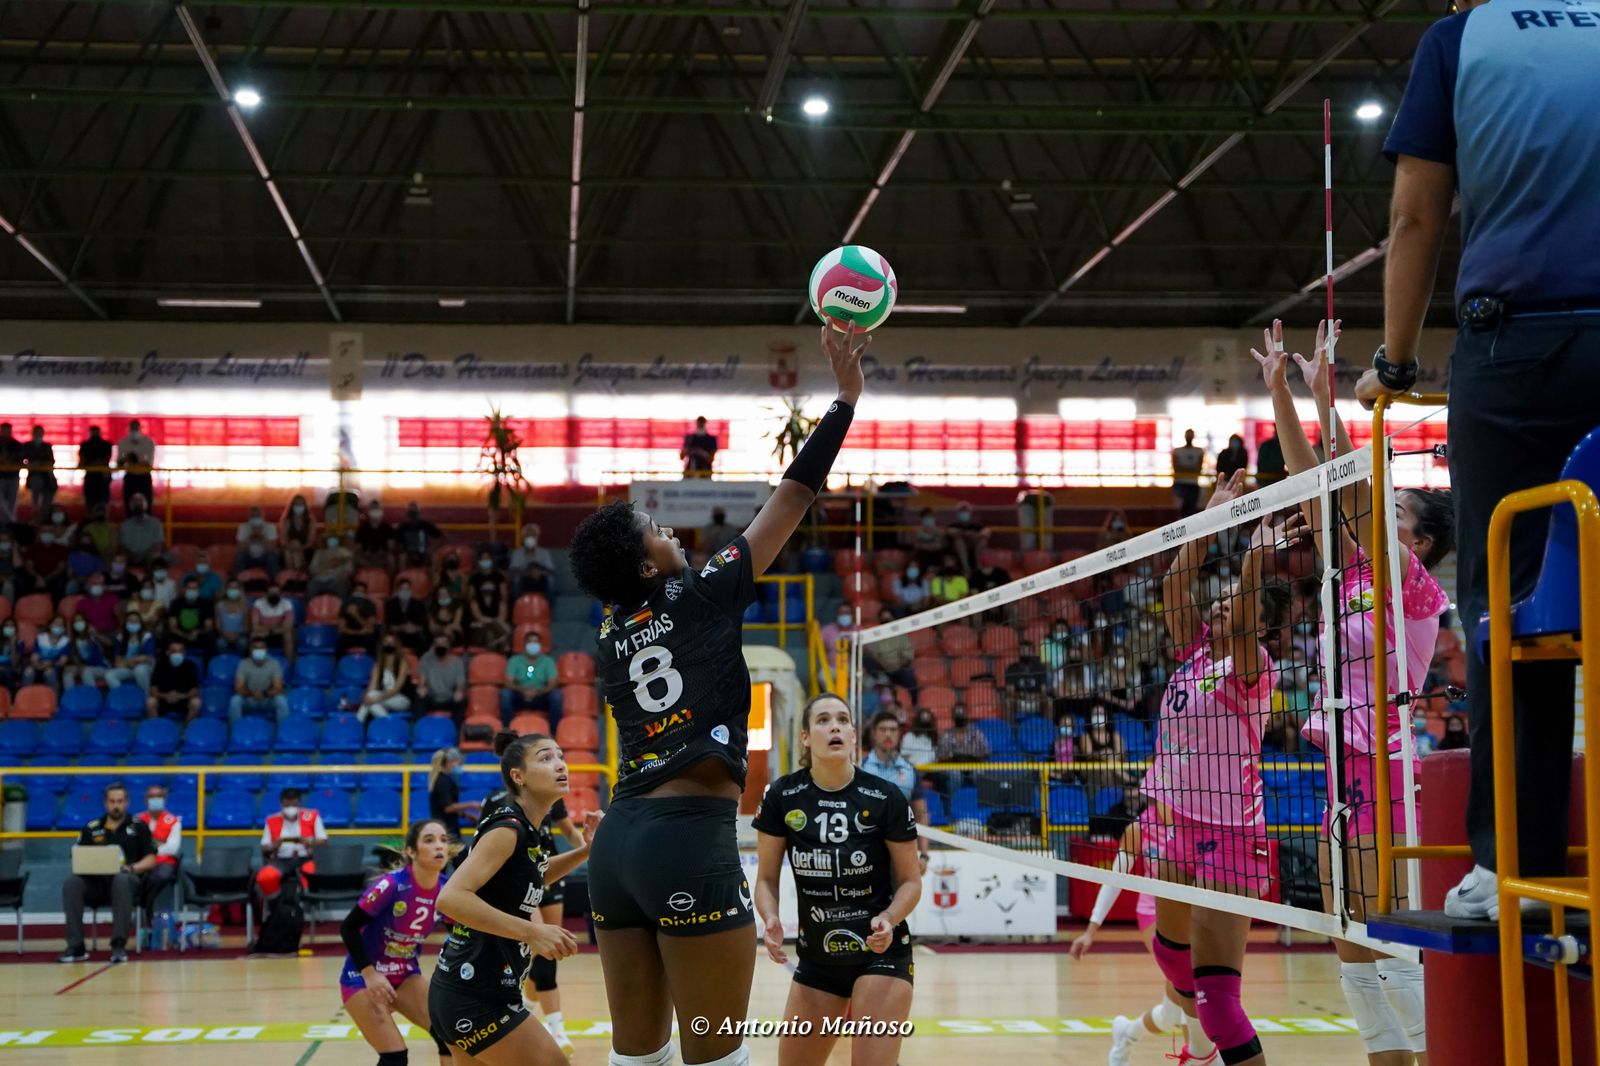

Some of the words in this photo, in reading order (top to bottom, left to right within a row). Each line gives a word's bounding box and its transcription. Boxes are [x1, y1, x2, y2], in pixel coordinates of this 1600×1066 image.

[834, 290, 871, 310] molten
[454, 353, 570, 381] Hermanas
[574, 352, 636, 386] Juega
[1230, 496, 1262, 519] rfevb.com
[1162, 524, 1187, 544] rfevb.com
[629, 645, 684, 713] 8
[814, 811, 849, 844] 13
[792, 846, 832, 870] berlin
[842, 864, 873, 876] JUVASA
[840, 885, 873, 899] Cajasol
[409, 906, 429, 931] 2
[659, 910, 722, 928] Divisa
[455, 1022, 498, 1051] Divisa
